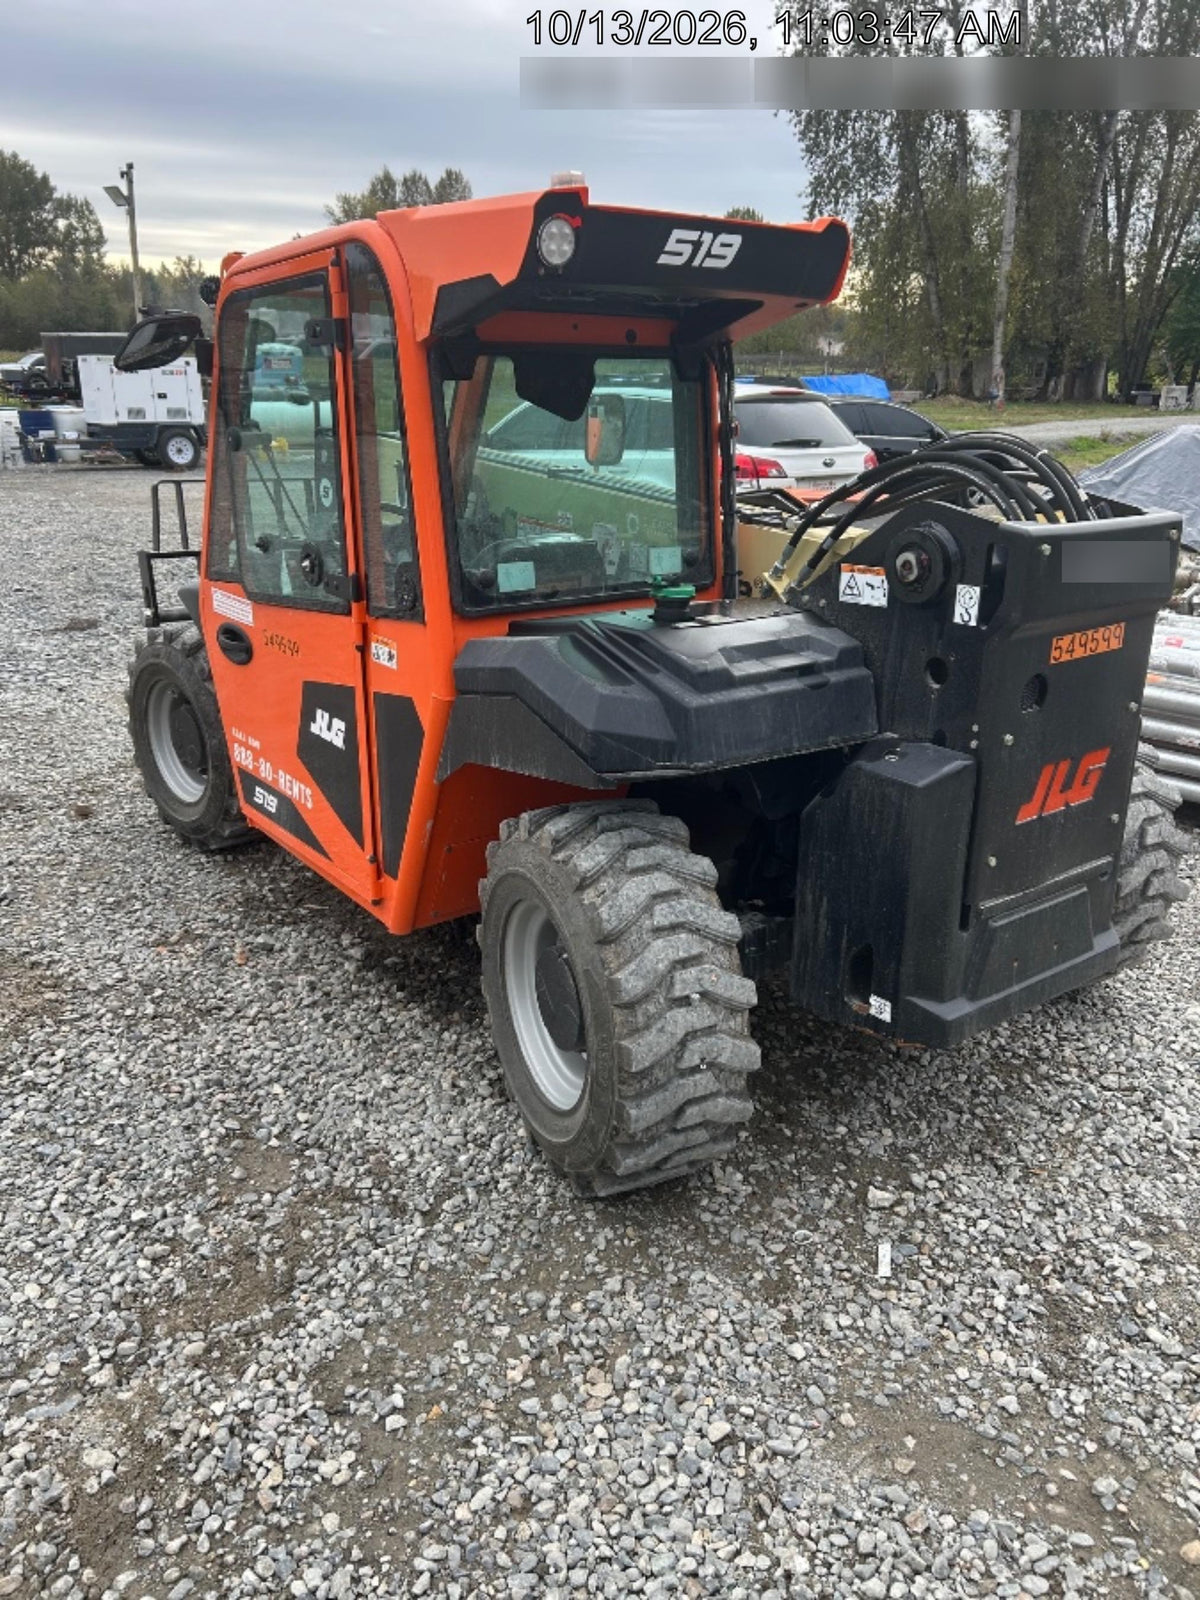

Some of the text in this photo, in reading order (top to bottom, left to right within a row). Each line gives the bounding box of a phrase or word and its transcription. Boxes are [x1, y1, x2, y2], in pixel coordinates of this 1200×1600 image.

[656, 229, 743, 269] 519
[1051, 624, 1124, 662] 549599
[309, 708, 346, 750] JLG
[253, 785, 278, 814] 519
[1015, 747, 1111, 825] JLG
